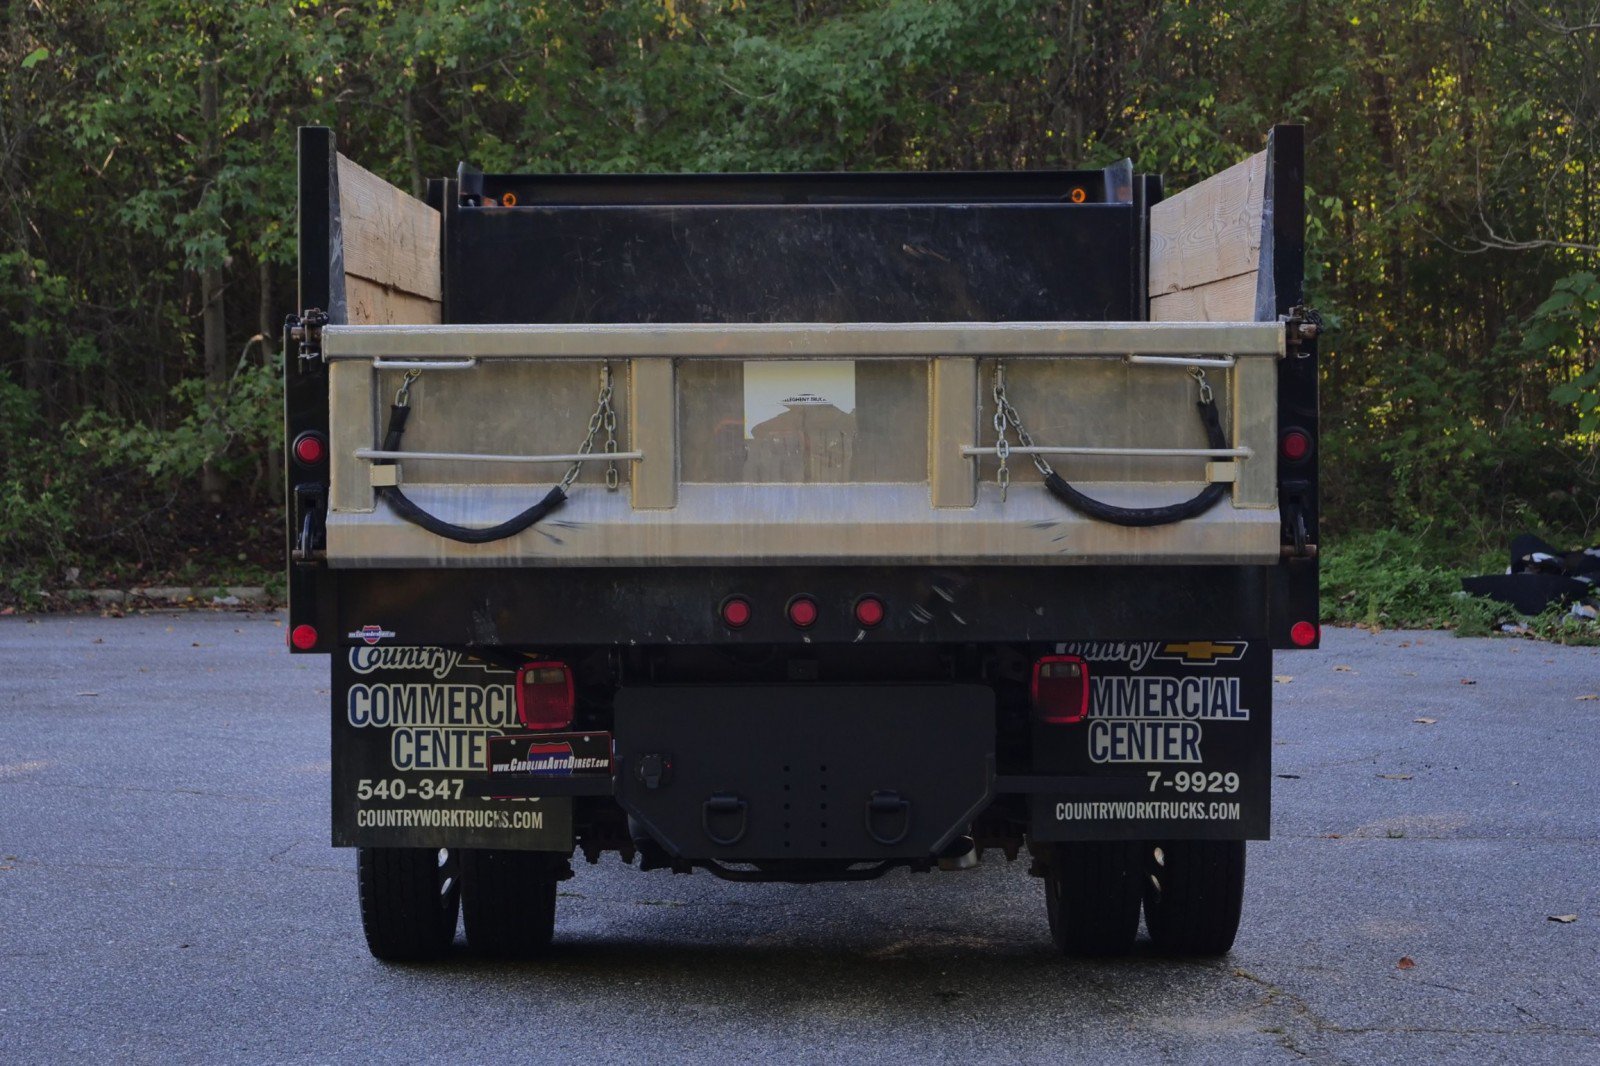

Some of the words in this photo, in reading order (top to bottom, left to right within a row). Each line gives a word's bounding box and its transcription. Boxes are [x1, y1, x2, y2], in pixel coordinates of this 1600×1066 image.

[349, 646, 457, 679] Country
[1055, 641, 1154, 672] ountry
[348, 684, 519, 728] COMMERCI
[1087, 676, 1249, 720] MMERCIAL
[390, 727, 505, 771] CENTE
[1088, 719, 1202, 764] CENTER
[1146, 771, 1240, 793] 7-9929
[357, 809, 543, 830] COUNTRYWORKTRUCKS.COM
[1055, 802, 1240, 821] COUNTRYWORKTRUCKS.COM
